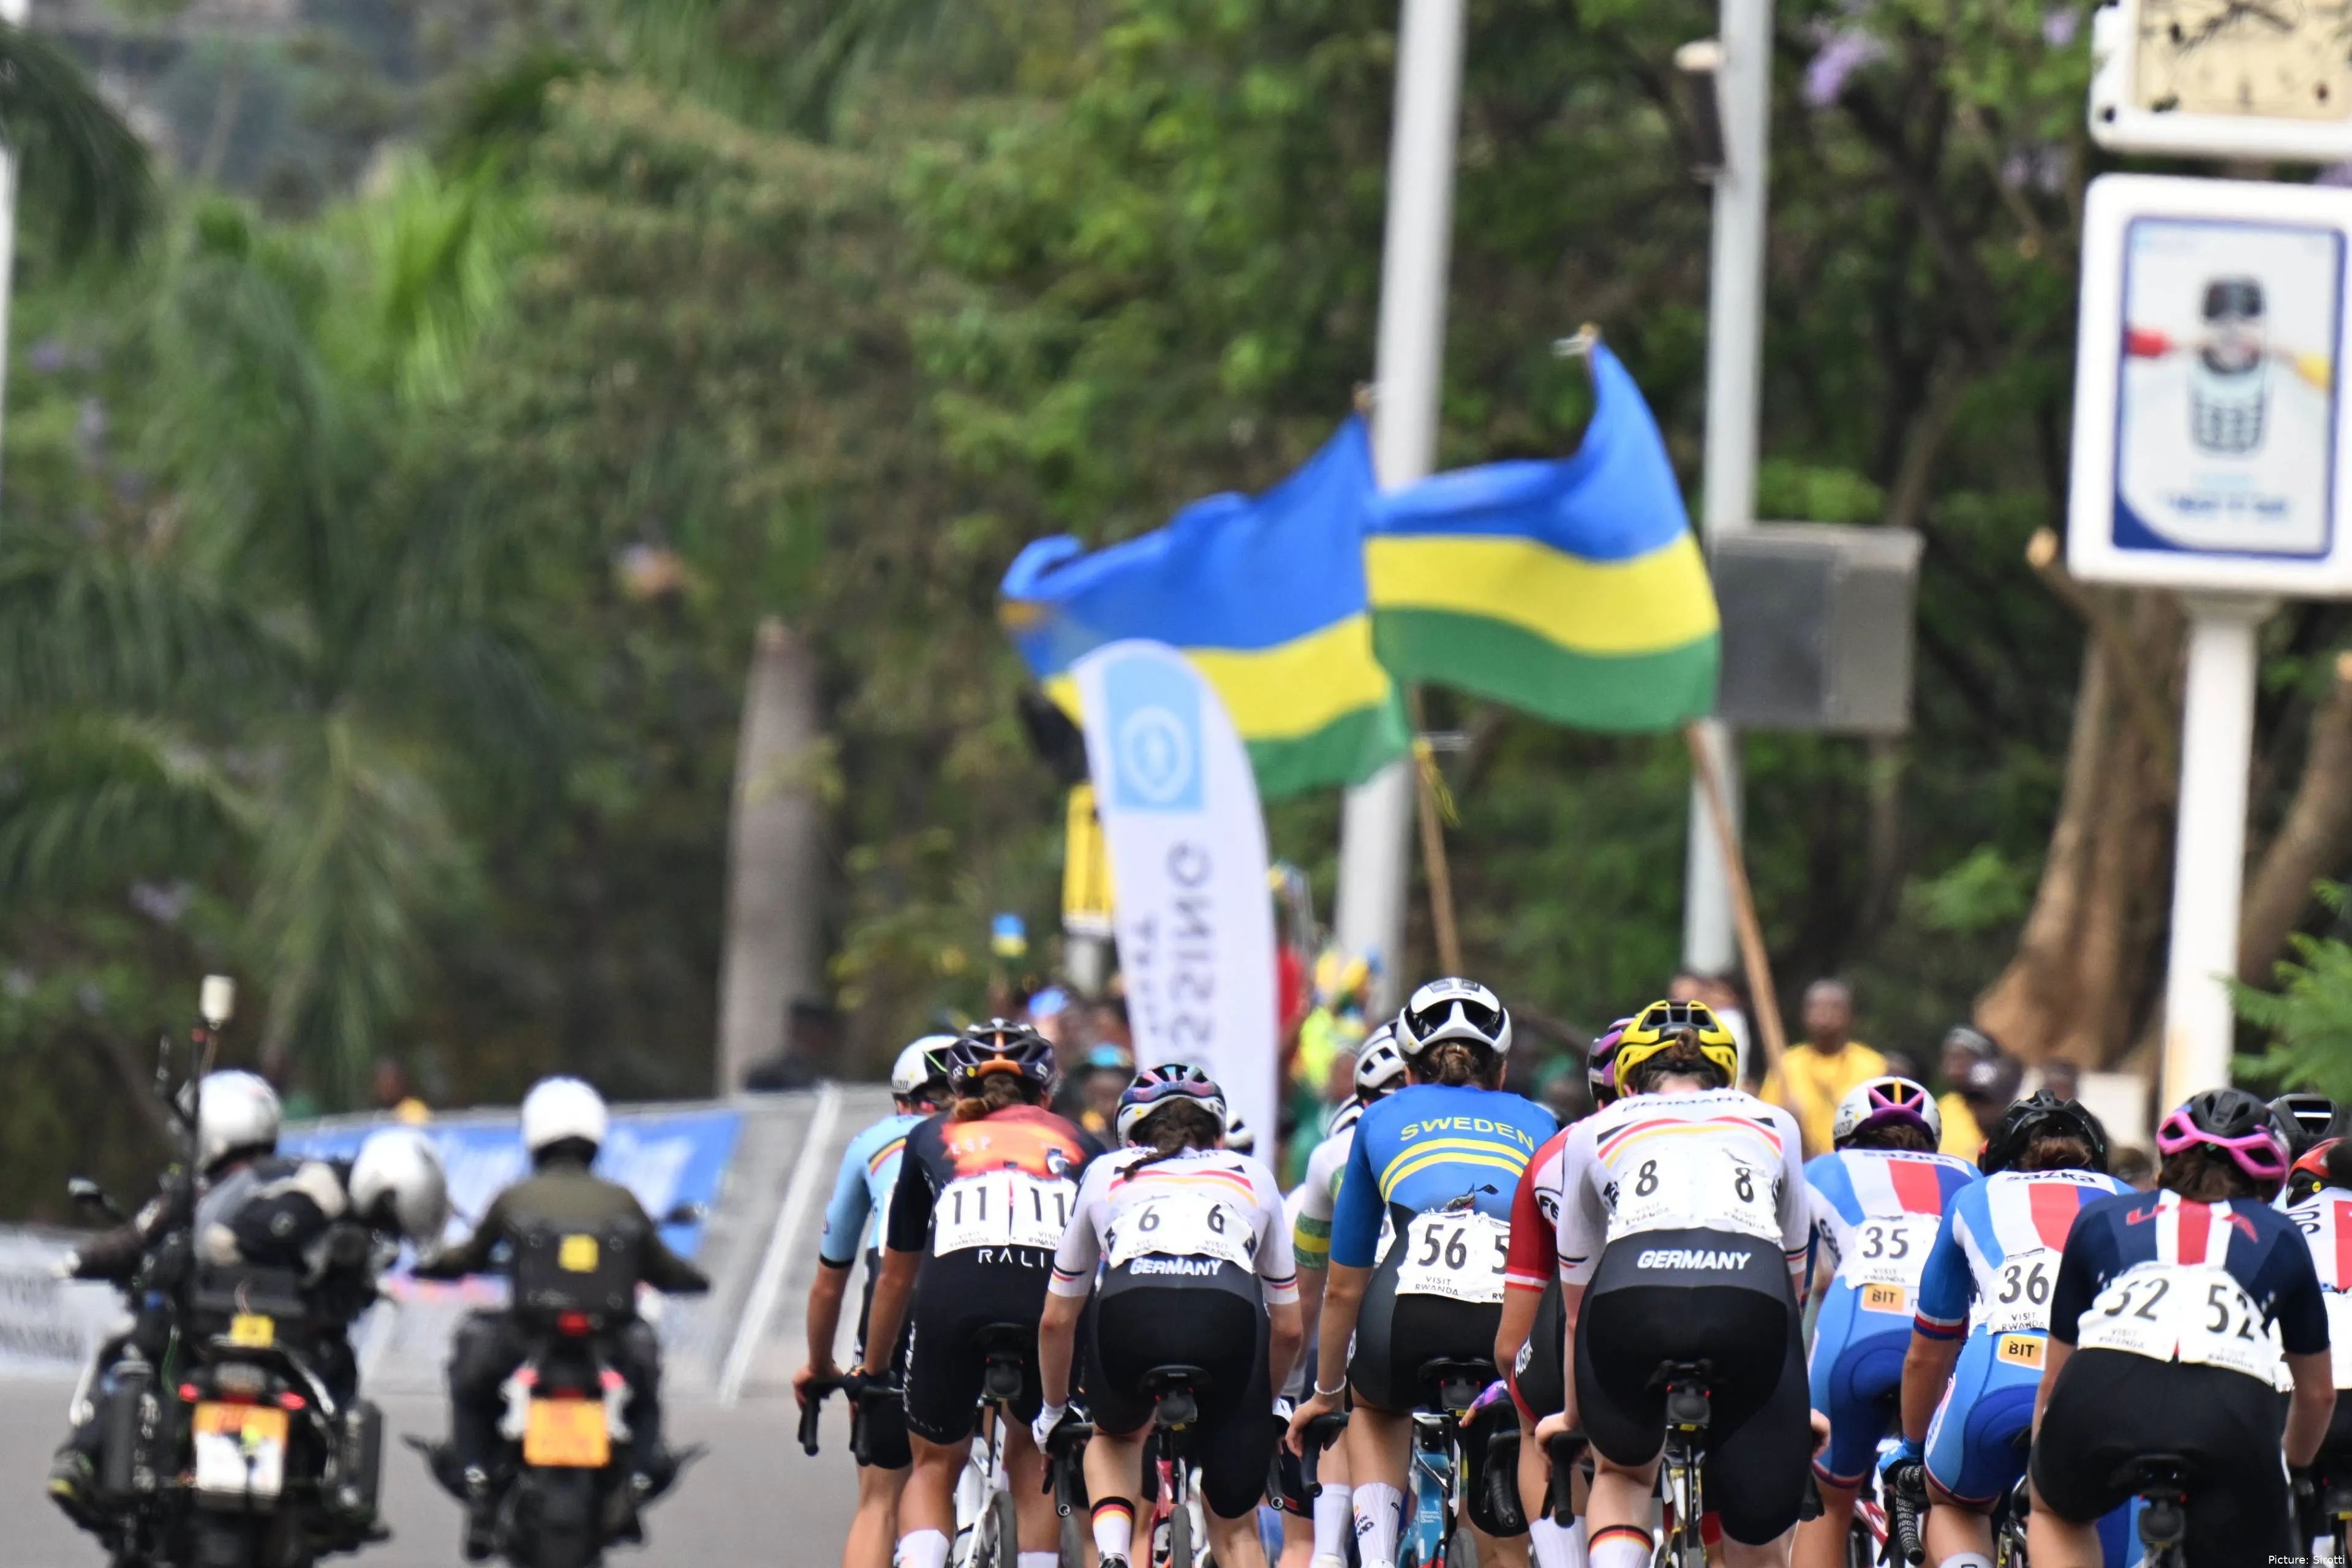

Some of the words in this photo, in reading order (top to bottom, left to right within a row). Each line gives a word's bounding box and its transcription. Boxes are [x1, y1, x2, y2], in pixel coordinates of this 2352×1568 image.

[1400, 1117, 1534, 1152] SWEDEN
[1635, 1159, 1659, 1197] 8
[1735, 1167, 1755, 1204] 8
[953, 1186, 987, 1226] 11
[1030, 1186, 1066, 1228] 11
[1138, 1205, 1160, 1232] 6
[1207, 1204, 1225, 1235] 6
[1417, 1223, 1468, 1271] 56
[1491, 1234, 1510, 1275] 5
[1862, 1226, 1909, 1259] 35
[1129, 1256, 1223, 1276] GERMANY
[1637, 1250, 1752, 1270] GERMANY
[1415, 1284, 1459, 1297] RWANDA
[1425, 1276, 1452, 1285] VISIT
[1872, 1289, 1896, 1303] BIT
[1998, 1262, 2049, 1305] 36
[2011, 1311, 2037, 1321] VISIT
[2104, 1278, 2169, 1322] 52
[2206, 1284, 2255, 1341] 52
[2002, 1321, 2046, 1332] RWANDA
[2008, 1341, 2035, 1358] BIT
